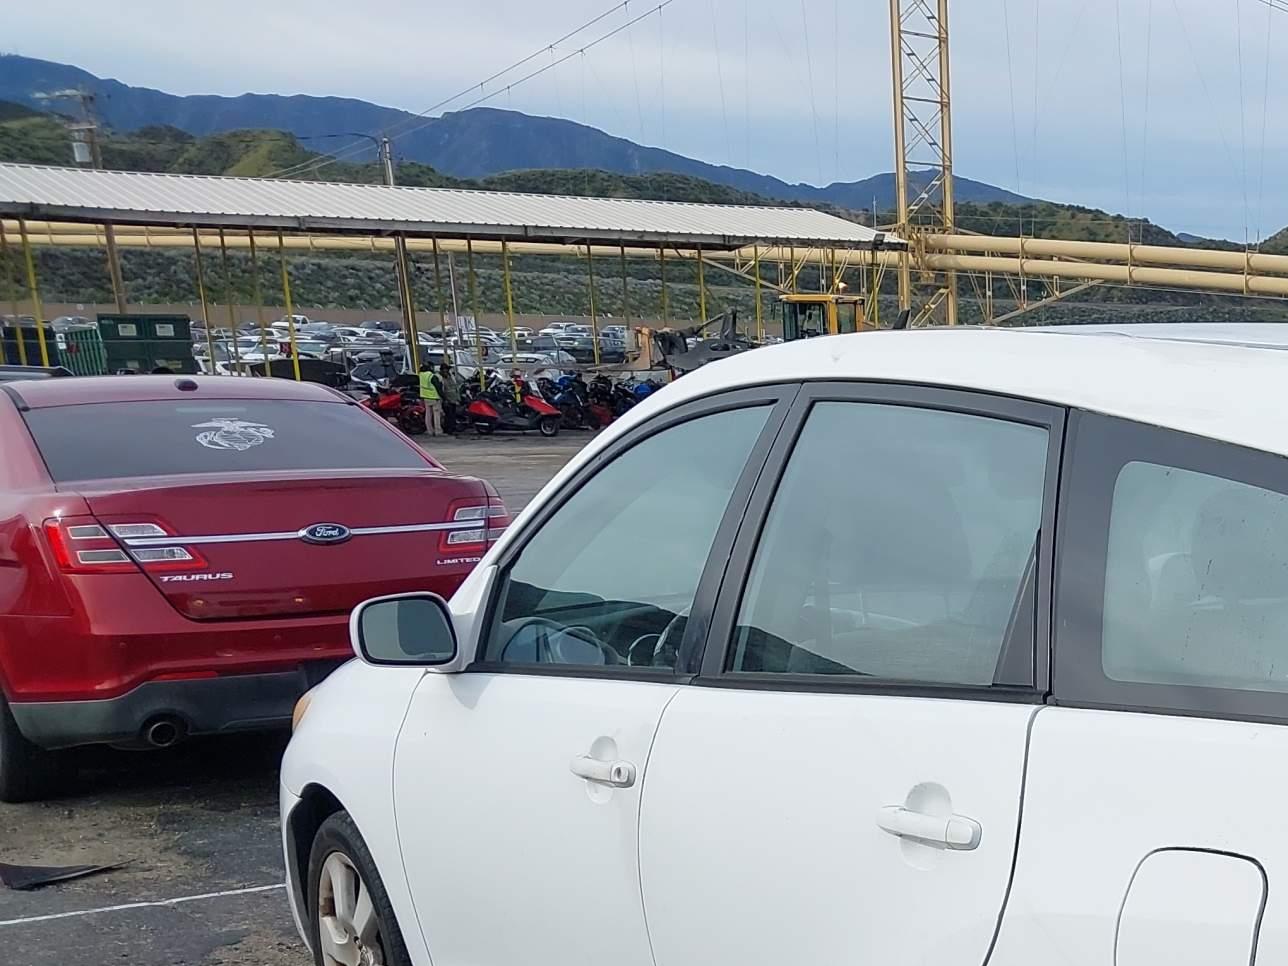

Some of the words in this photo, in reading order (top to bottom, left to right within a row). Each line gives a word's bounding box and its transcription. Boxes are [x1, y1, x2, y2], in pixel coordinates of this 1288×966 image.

[315, 525, 340, 537] Ford
[436, 557, 481, 565] LIMITED
[159, 572, 234, 582] TAURUS
